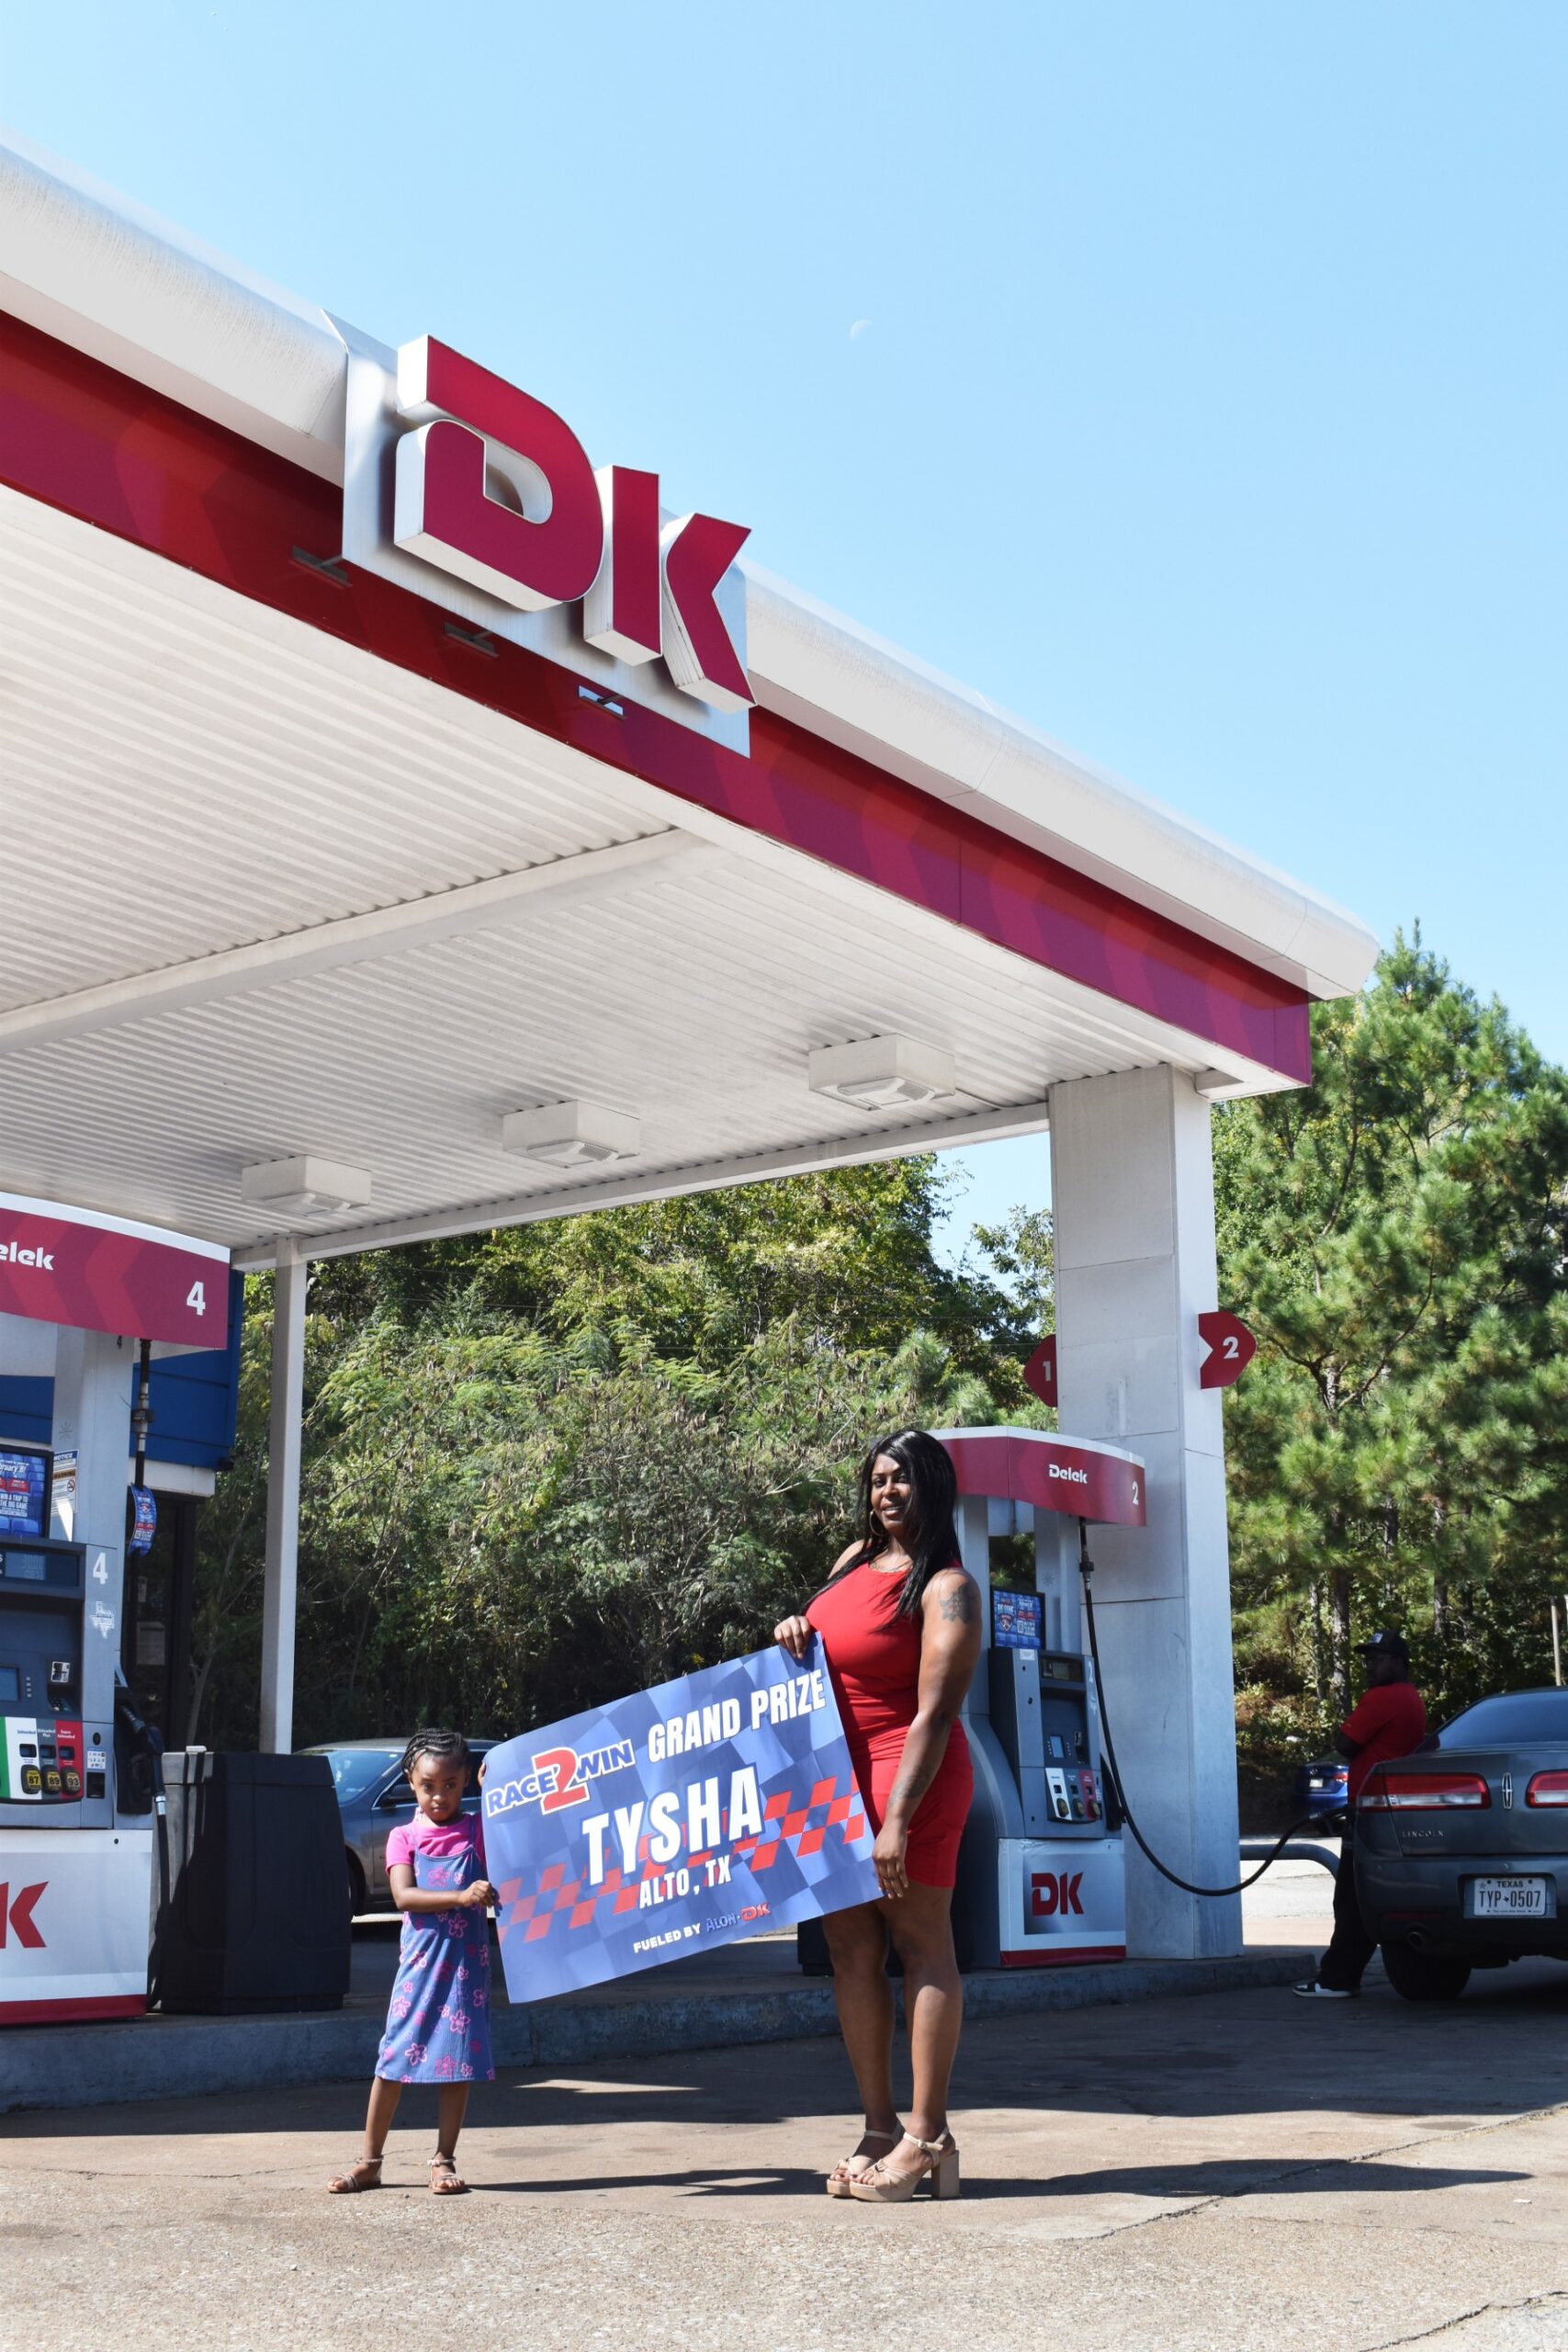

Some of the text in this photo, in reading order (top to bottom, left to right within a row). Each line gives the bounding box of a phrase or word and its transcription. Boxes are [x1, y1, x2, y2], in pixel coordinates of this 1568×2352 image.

[395, 334, 756, 713] DK
[186, 1281, 207, 1317] 4
[1223, 1336, 1239, 1360] 2
[1043, 1361, 1052, 1382] 1
[1048, 1464, 1088, 1484] Delek
[1132, 1481, 1139, 1505] 2
[93, 1552, 108, 1585] 4
[648, 1668, 826, 1762] GRAND PRIZE
[28, 1776, 39, 1785] 87
[49, 1776, 60, 1785] 89
[68, 1777, 79, 1786] 93
[487, 1770, 558, 1815] RACE
[576, 1741, 636, 1782] WIN
[581, 1766, 762, 1886] TYSHA
[705, 1855, 732, 1887] TX
[1032, 1871, 1084, 1917] DK
[1480, 1891, 1540, 1907] TYP 0507
[633, 1902, 772, 1953] FUELED BY ALON DK
